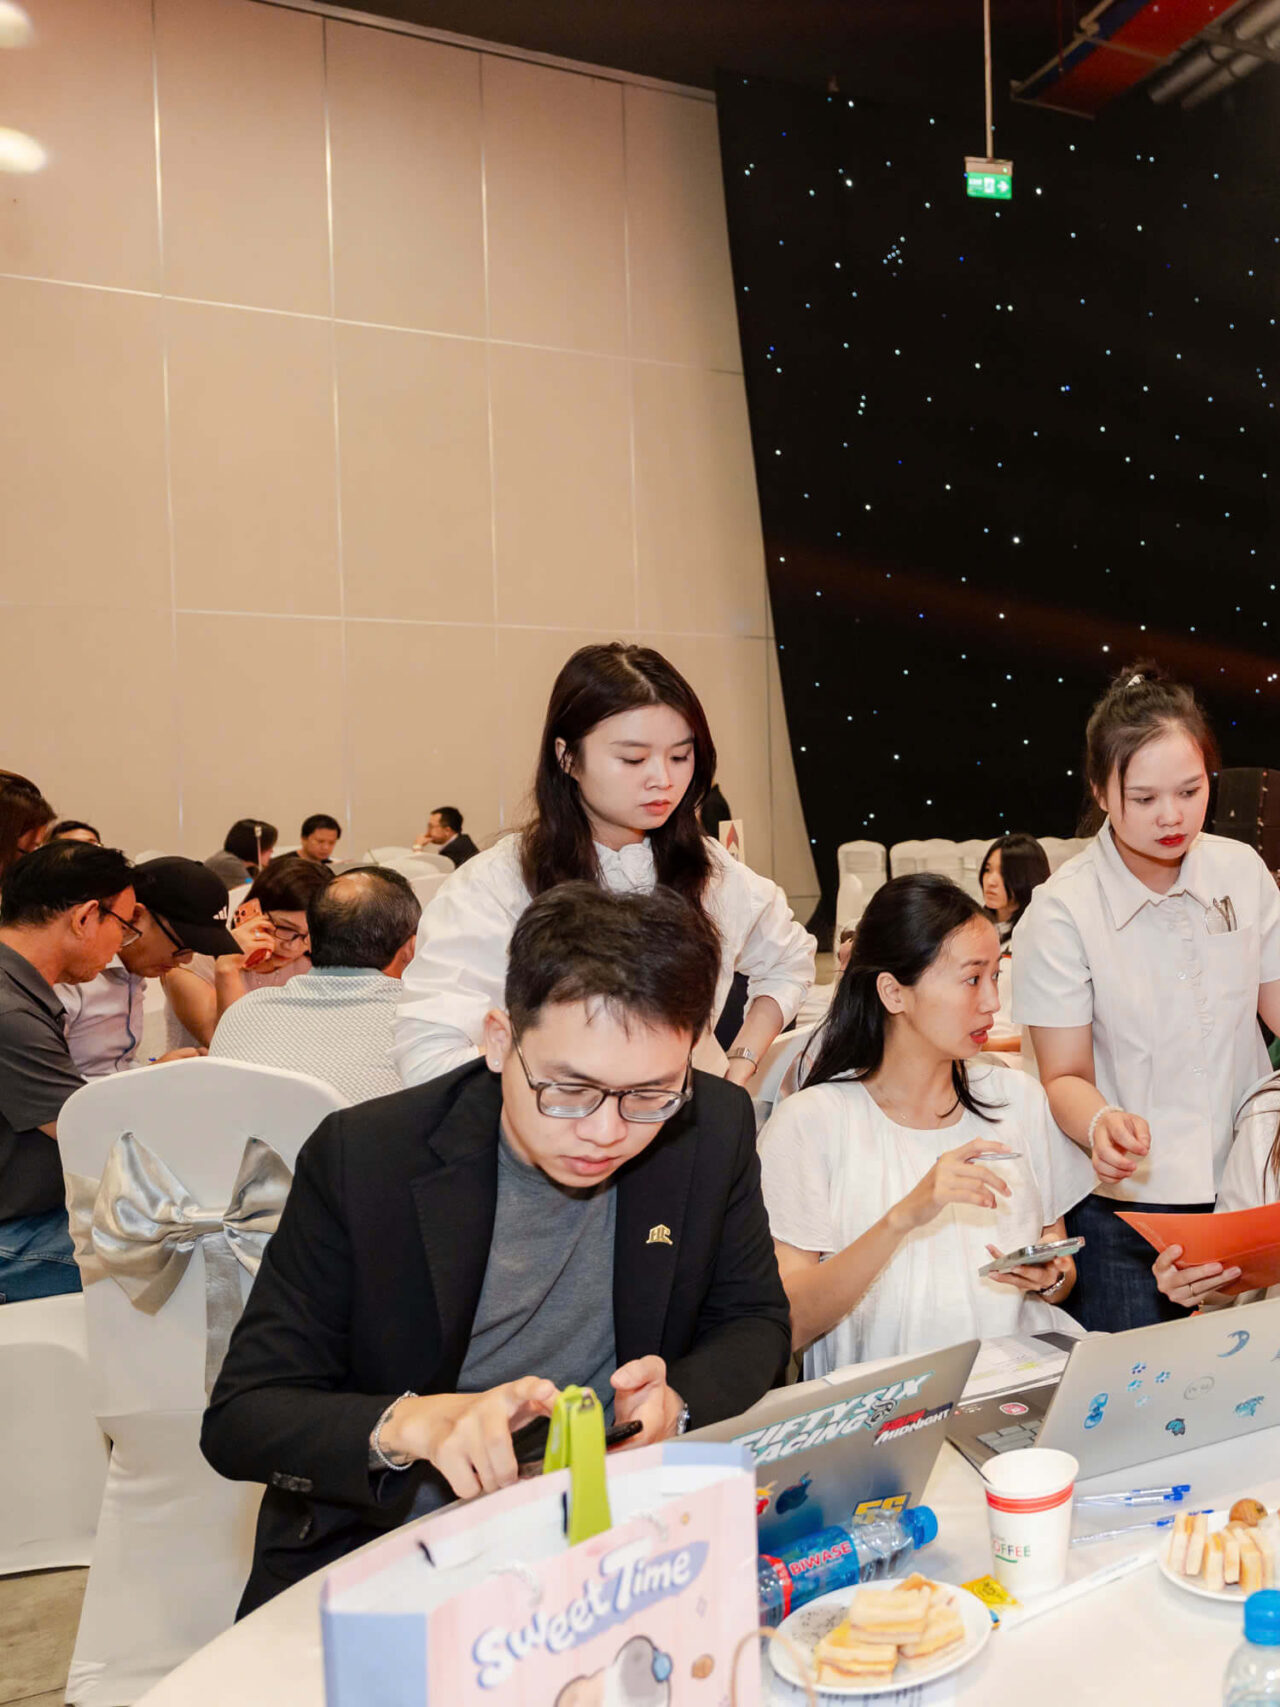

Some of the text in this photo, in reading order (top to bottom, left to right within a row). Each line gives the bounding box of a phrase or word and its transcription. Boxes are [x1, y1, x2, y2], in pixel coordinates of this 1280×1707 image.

[751, 1411, 869, 1466] ACING
[788, 1541, 852, 1576] BIWASE
[992, 1539, 1031, 1558] OFFEE
[600, 1537, 692, 1612] Time
